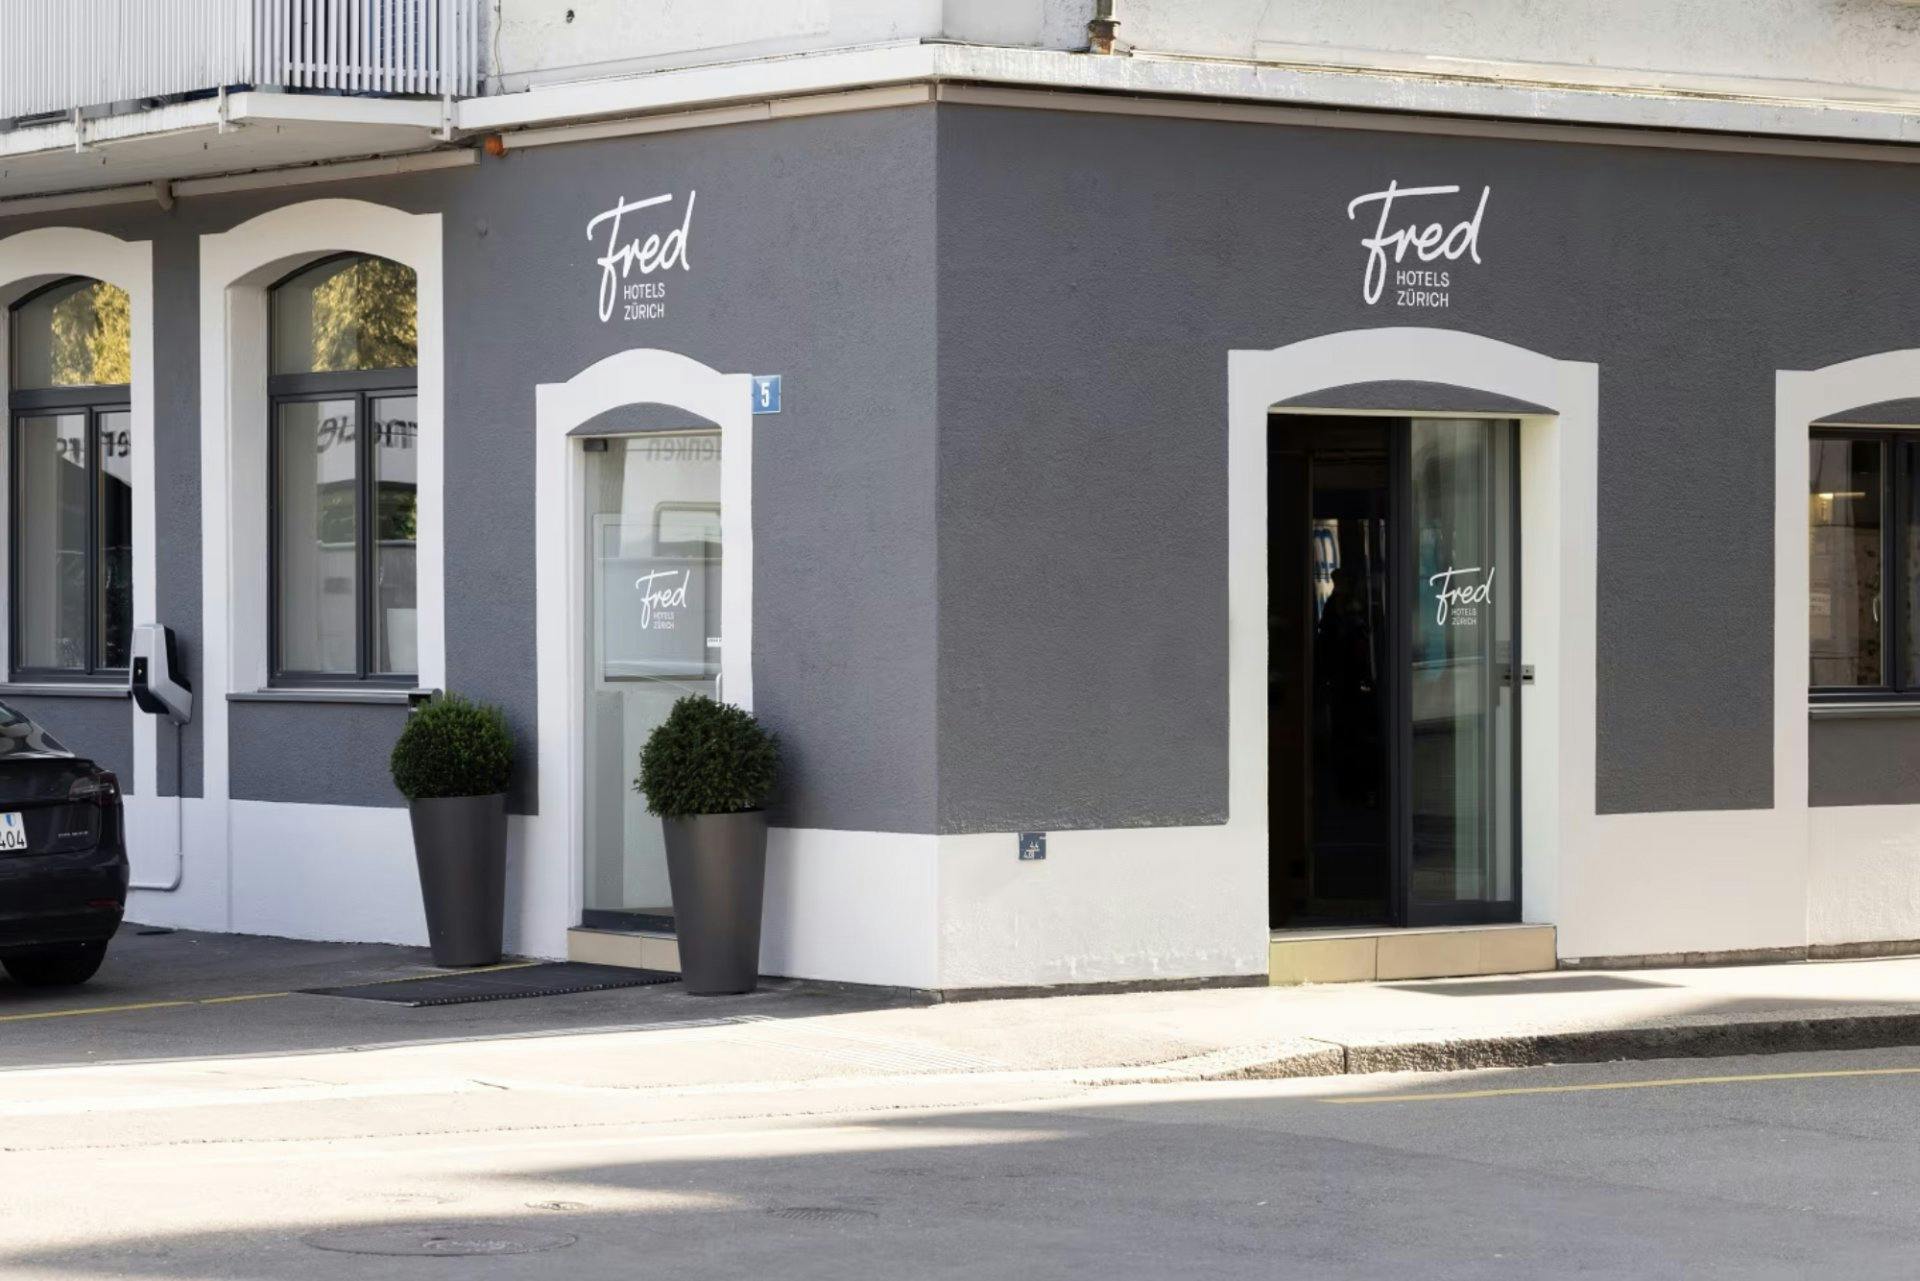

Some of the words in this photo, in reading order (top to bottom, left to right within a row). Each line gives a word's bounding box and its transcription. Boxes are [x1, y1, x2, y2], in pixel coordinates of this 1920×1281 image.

[1347, 179, 1490, 305] Fred
[586, 189, 696, 322] Fred
[1396, 270, 1450, 288] HOTELS
[623, 282, 666, 300] HOTELS
[1397, 289, 1449, 308] ZÜRICH
[623, 302, 665, 321] ZÜRICH
[760, 382, 770, 408] 5
[635, 569, 690, 629] Fred
[1429, 566, 1495, 626] Fred
[1451, 607, 1478, 616] HOTELS
